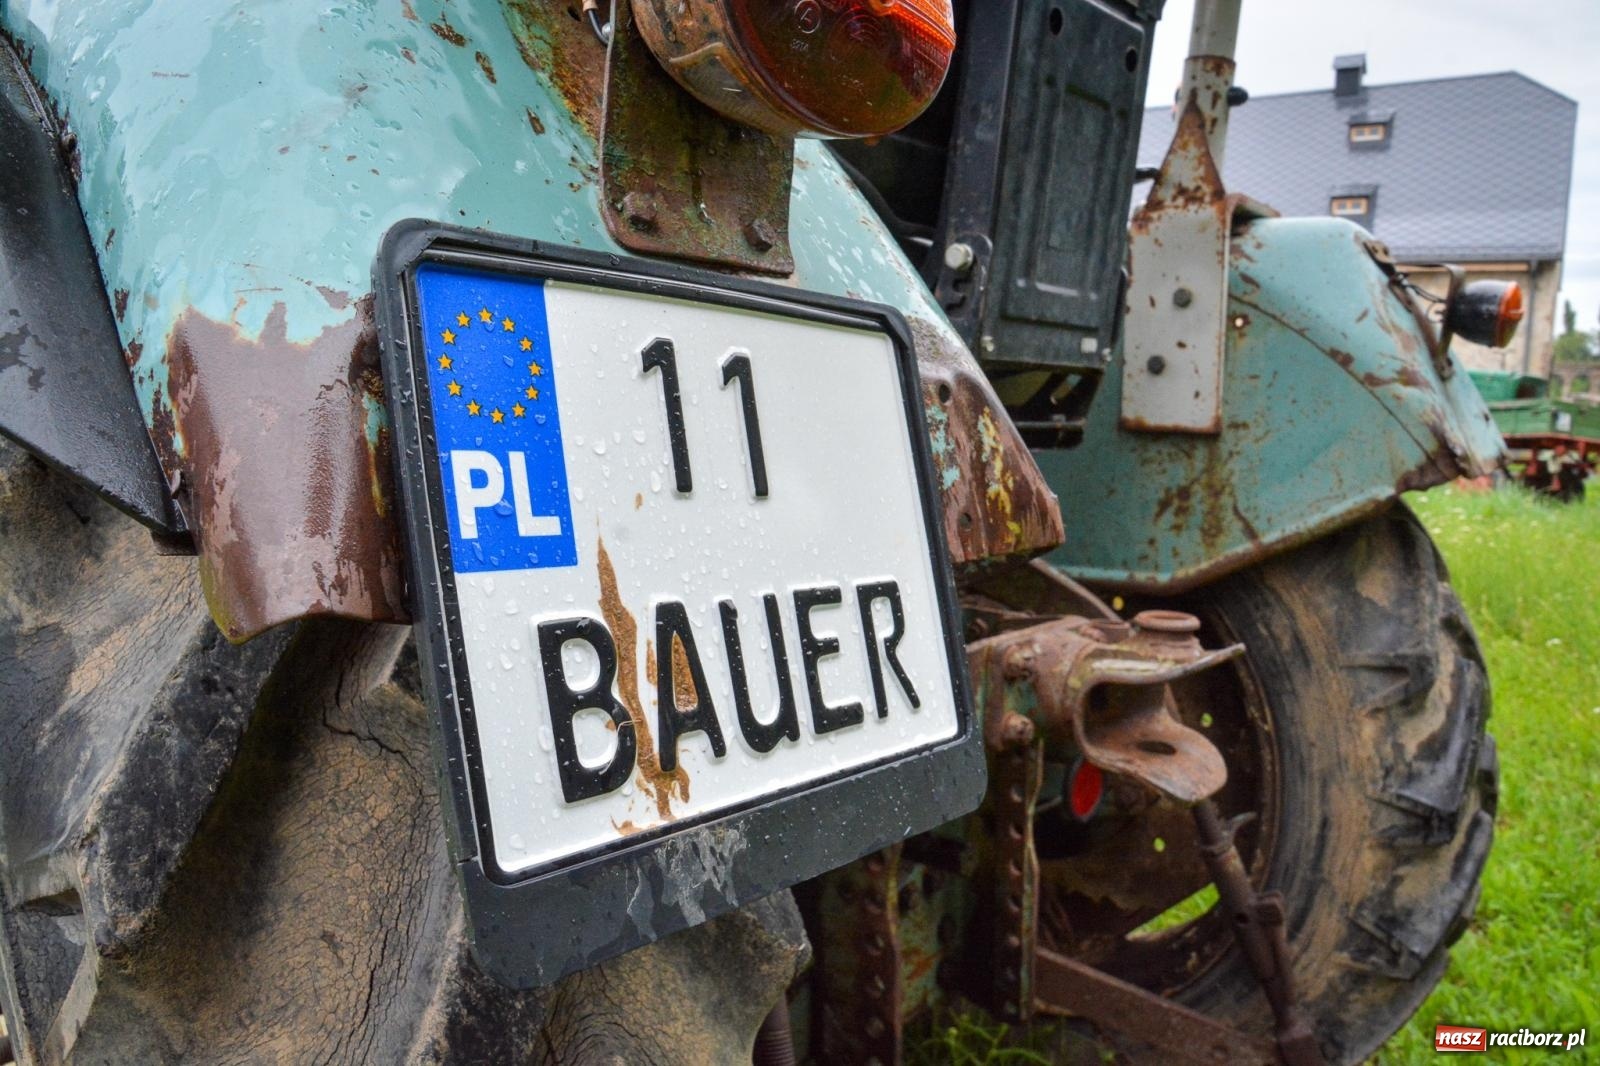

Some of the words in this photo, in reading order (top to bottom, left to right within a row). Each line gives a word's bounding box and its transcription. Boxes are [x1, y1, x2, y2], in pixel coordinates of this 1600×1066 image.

[451, 449, 562, 539] PL
[640, 336, 769, 498] 11
[536, 580, 921, 803] BAUER
